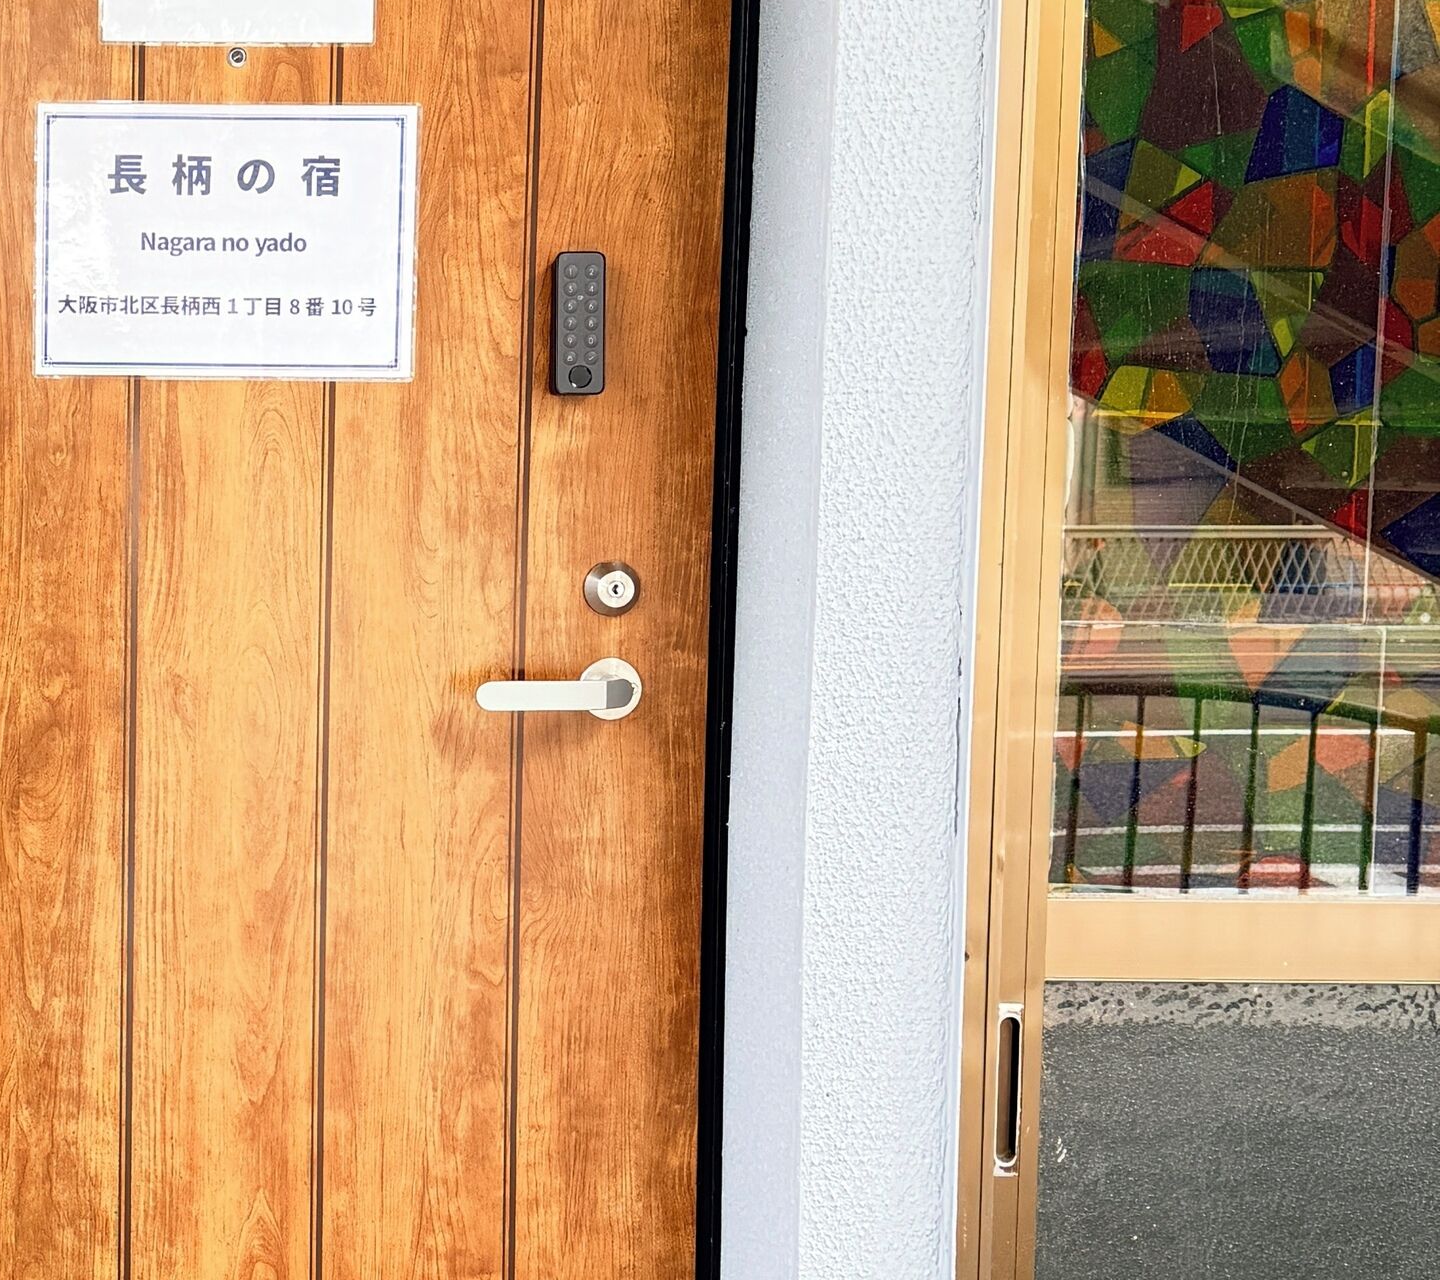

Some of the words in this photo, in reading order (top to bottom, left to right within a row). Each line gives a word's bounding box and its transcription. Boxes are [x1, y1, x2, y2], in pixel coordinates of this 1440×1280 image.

[107, 153, 341, 197] 長柄の宿
[140, 232, 216, 257] Nagara
[222, 237, 250, 252] no
[254, 232, 307, 258] yado
